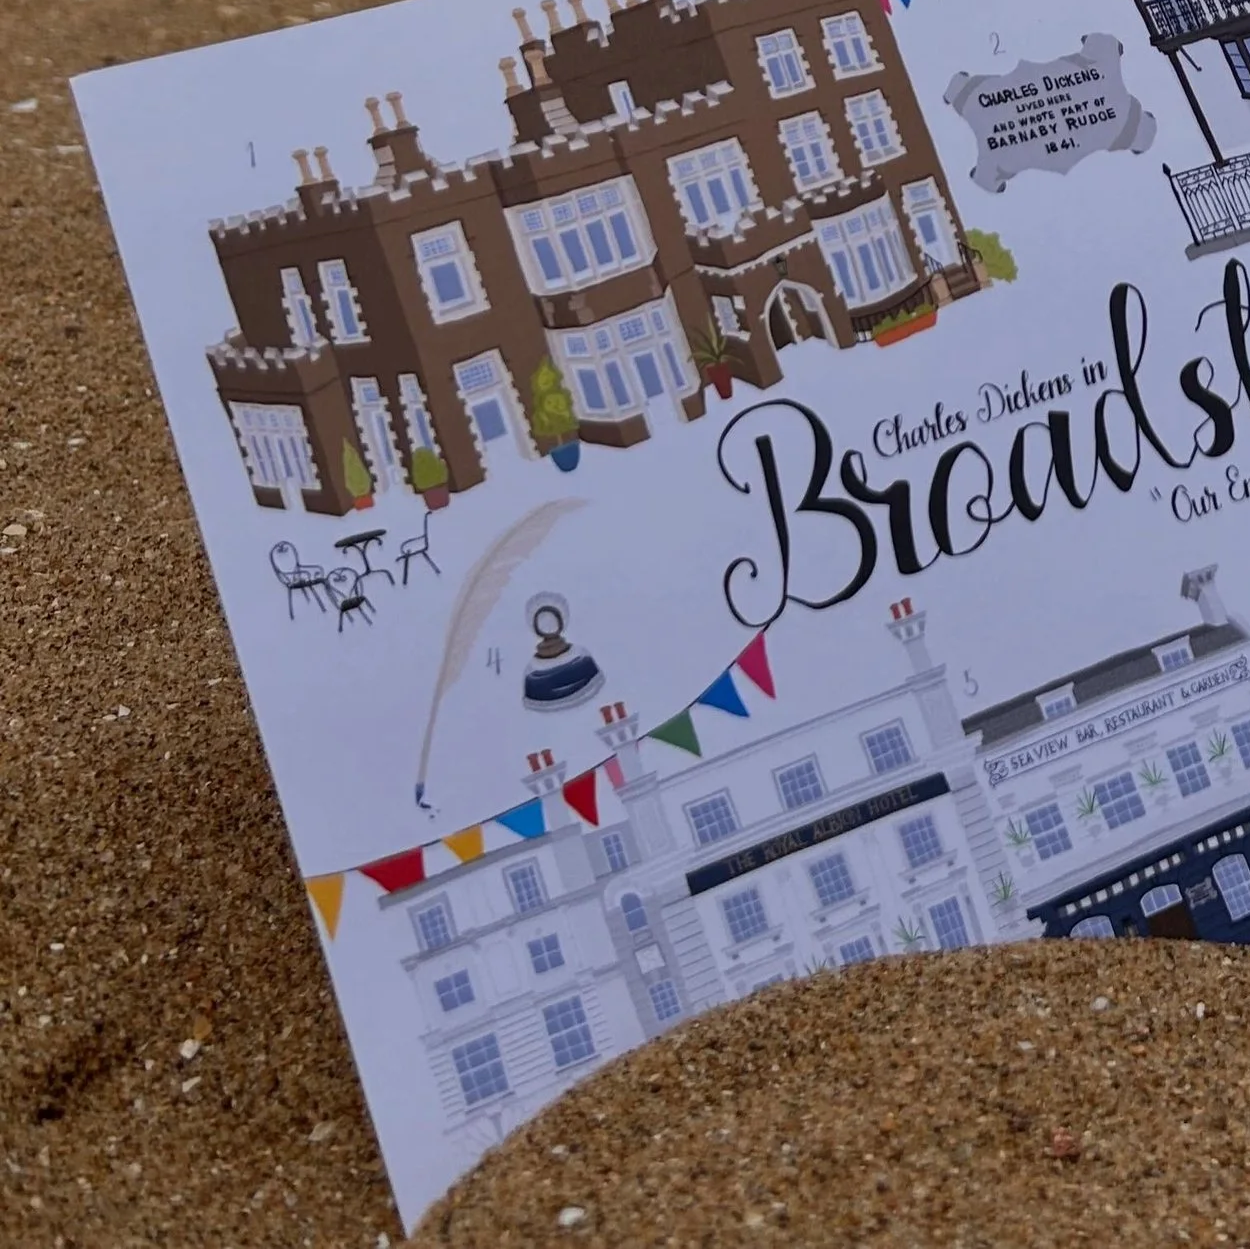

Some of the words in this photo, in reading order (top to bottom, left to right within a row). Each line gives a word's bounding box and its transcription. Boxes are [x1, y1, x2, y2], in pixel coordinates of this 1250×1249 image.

[989, 31, 1006, 56] 2
[978, 82, 1039, 108] CHARLES
[1016, 99, 1045, 114] LIVED
[1047, 93, 1072, 107] HERE
[992, 120, 1016, 135] AND
[1018, 110, 1055, 128] WROTE
[1061, 101, 1090, 117] PART
[1094, 96, 1107, 108] OF
[986, 123, 1058, 151] BARNABY
[245, 141, 256, 169] 1
[872, 401, 968, 459] Charles
[976, 369, 1075, 424] Dickens
[1080, 357, 1108, 387] in
[486, 647, 505, 676] 4
[963, 664, 979, 698] 5
[1010, 735, 1069, 771] SEAVIEW
[1103, 693, 1176, 732] RESTAURANT
[726, 851, 757, 876] THE
[762, 830, 808, 863] ROYAL
[812, 808, 861, 840] ALBION
[867, 785, 920, 814] HOTEL
